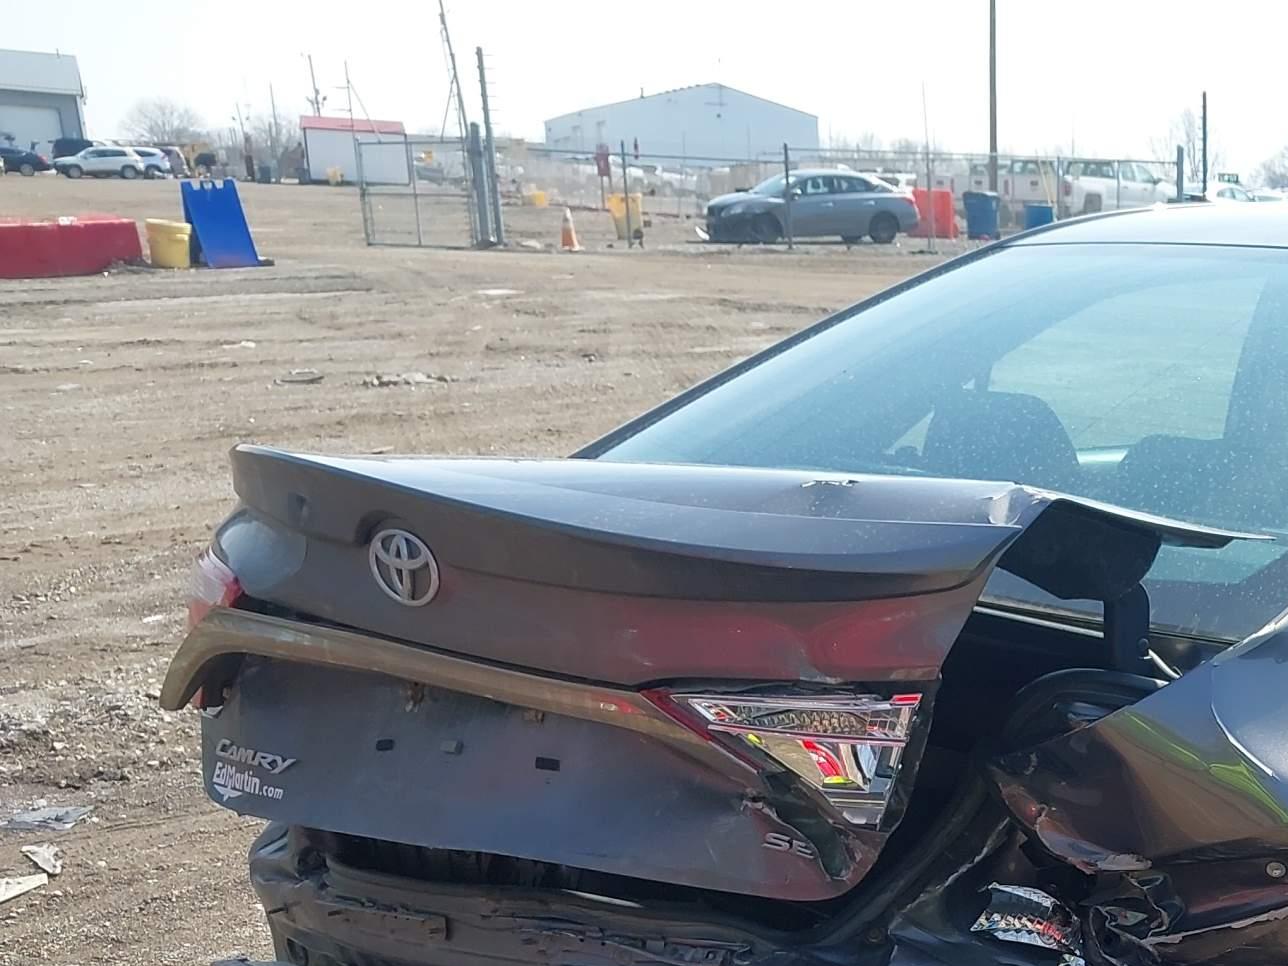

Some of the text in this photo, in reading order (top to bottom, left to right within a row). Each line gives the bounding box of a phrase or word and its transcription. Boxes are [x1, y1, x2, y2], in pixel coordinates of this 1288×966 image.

[215, 738, 297, 775] CAMRY
[212, 761, 284, 800] EdMartin.com
[761, 832, 815, 859] SE
